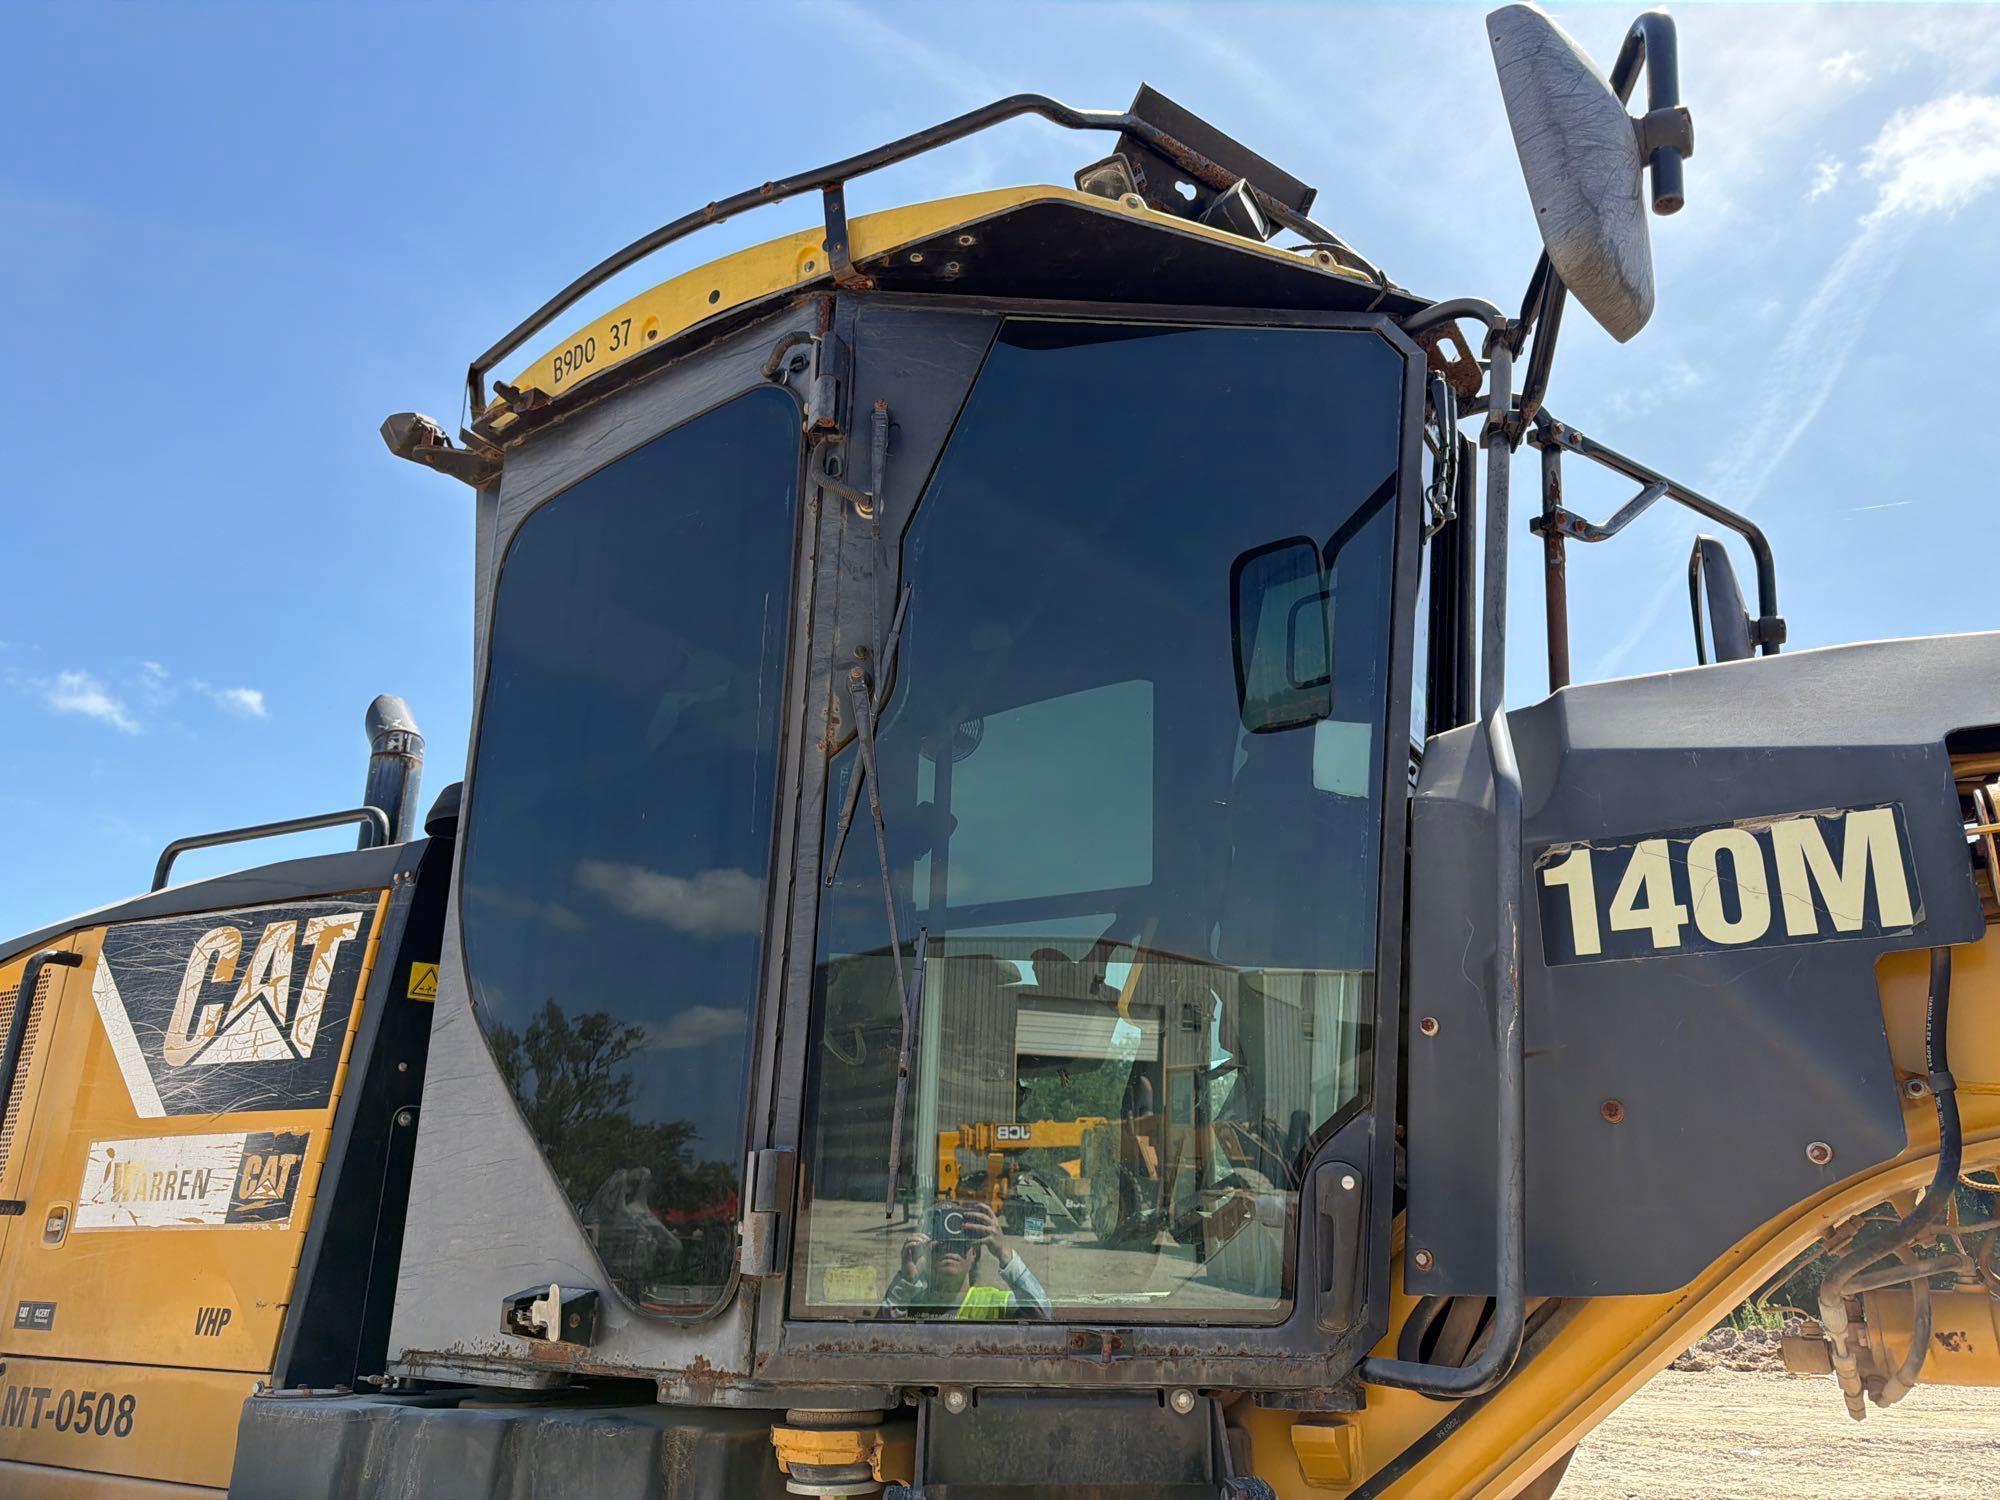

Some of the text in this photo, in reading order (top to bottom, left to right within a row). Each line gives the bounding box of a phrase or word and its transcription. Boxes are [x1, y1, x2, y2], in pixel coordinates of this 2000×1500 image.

[609, 317, 632, 352] 37
[1543, 807, 1914, 956] 140M
[162, 911, 364, 1067] CAT
[111, 1153, 297, 1202] WARREN CAT
[194, 1306, 232, 1337] VHP
[0, 1385, 136, 1438] MT-0508
